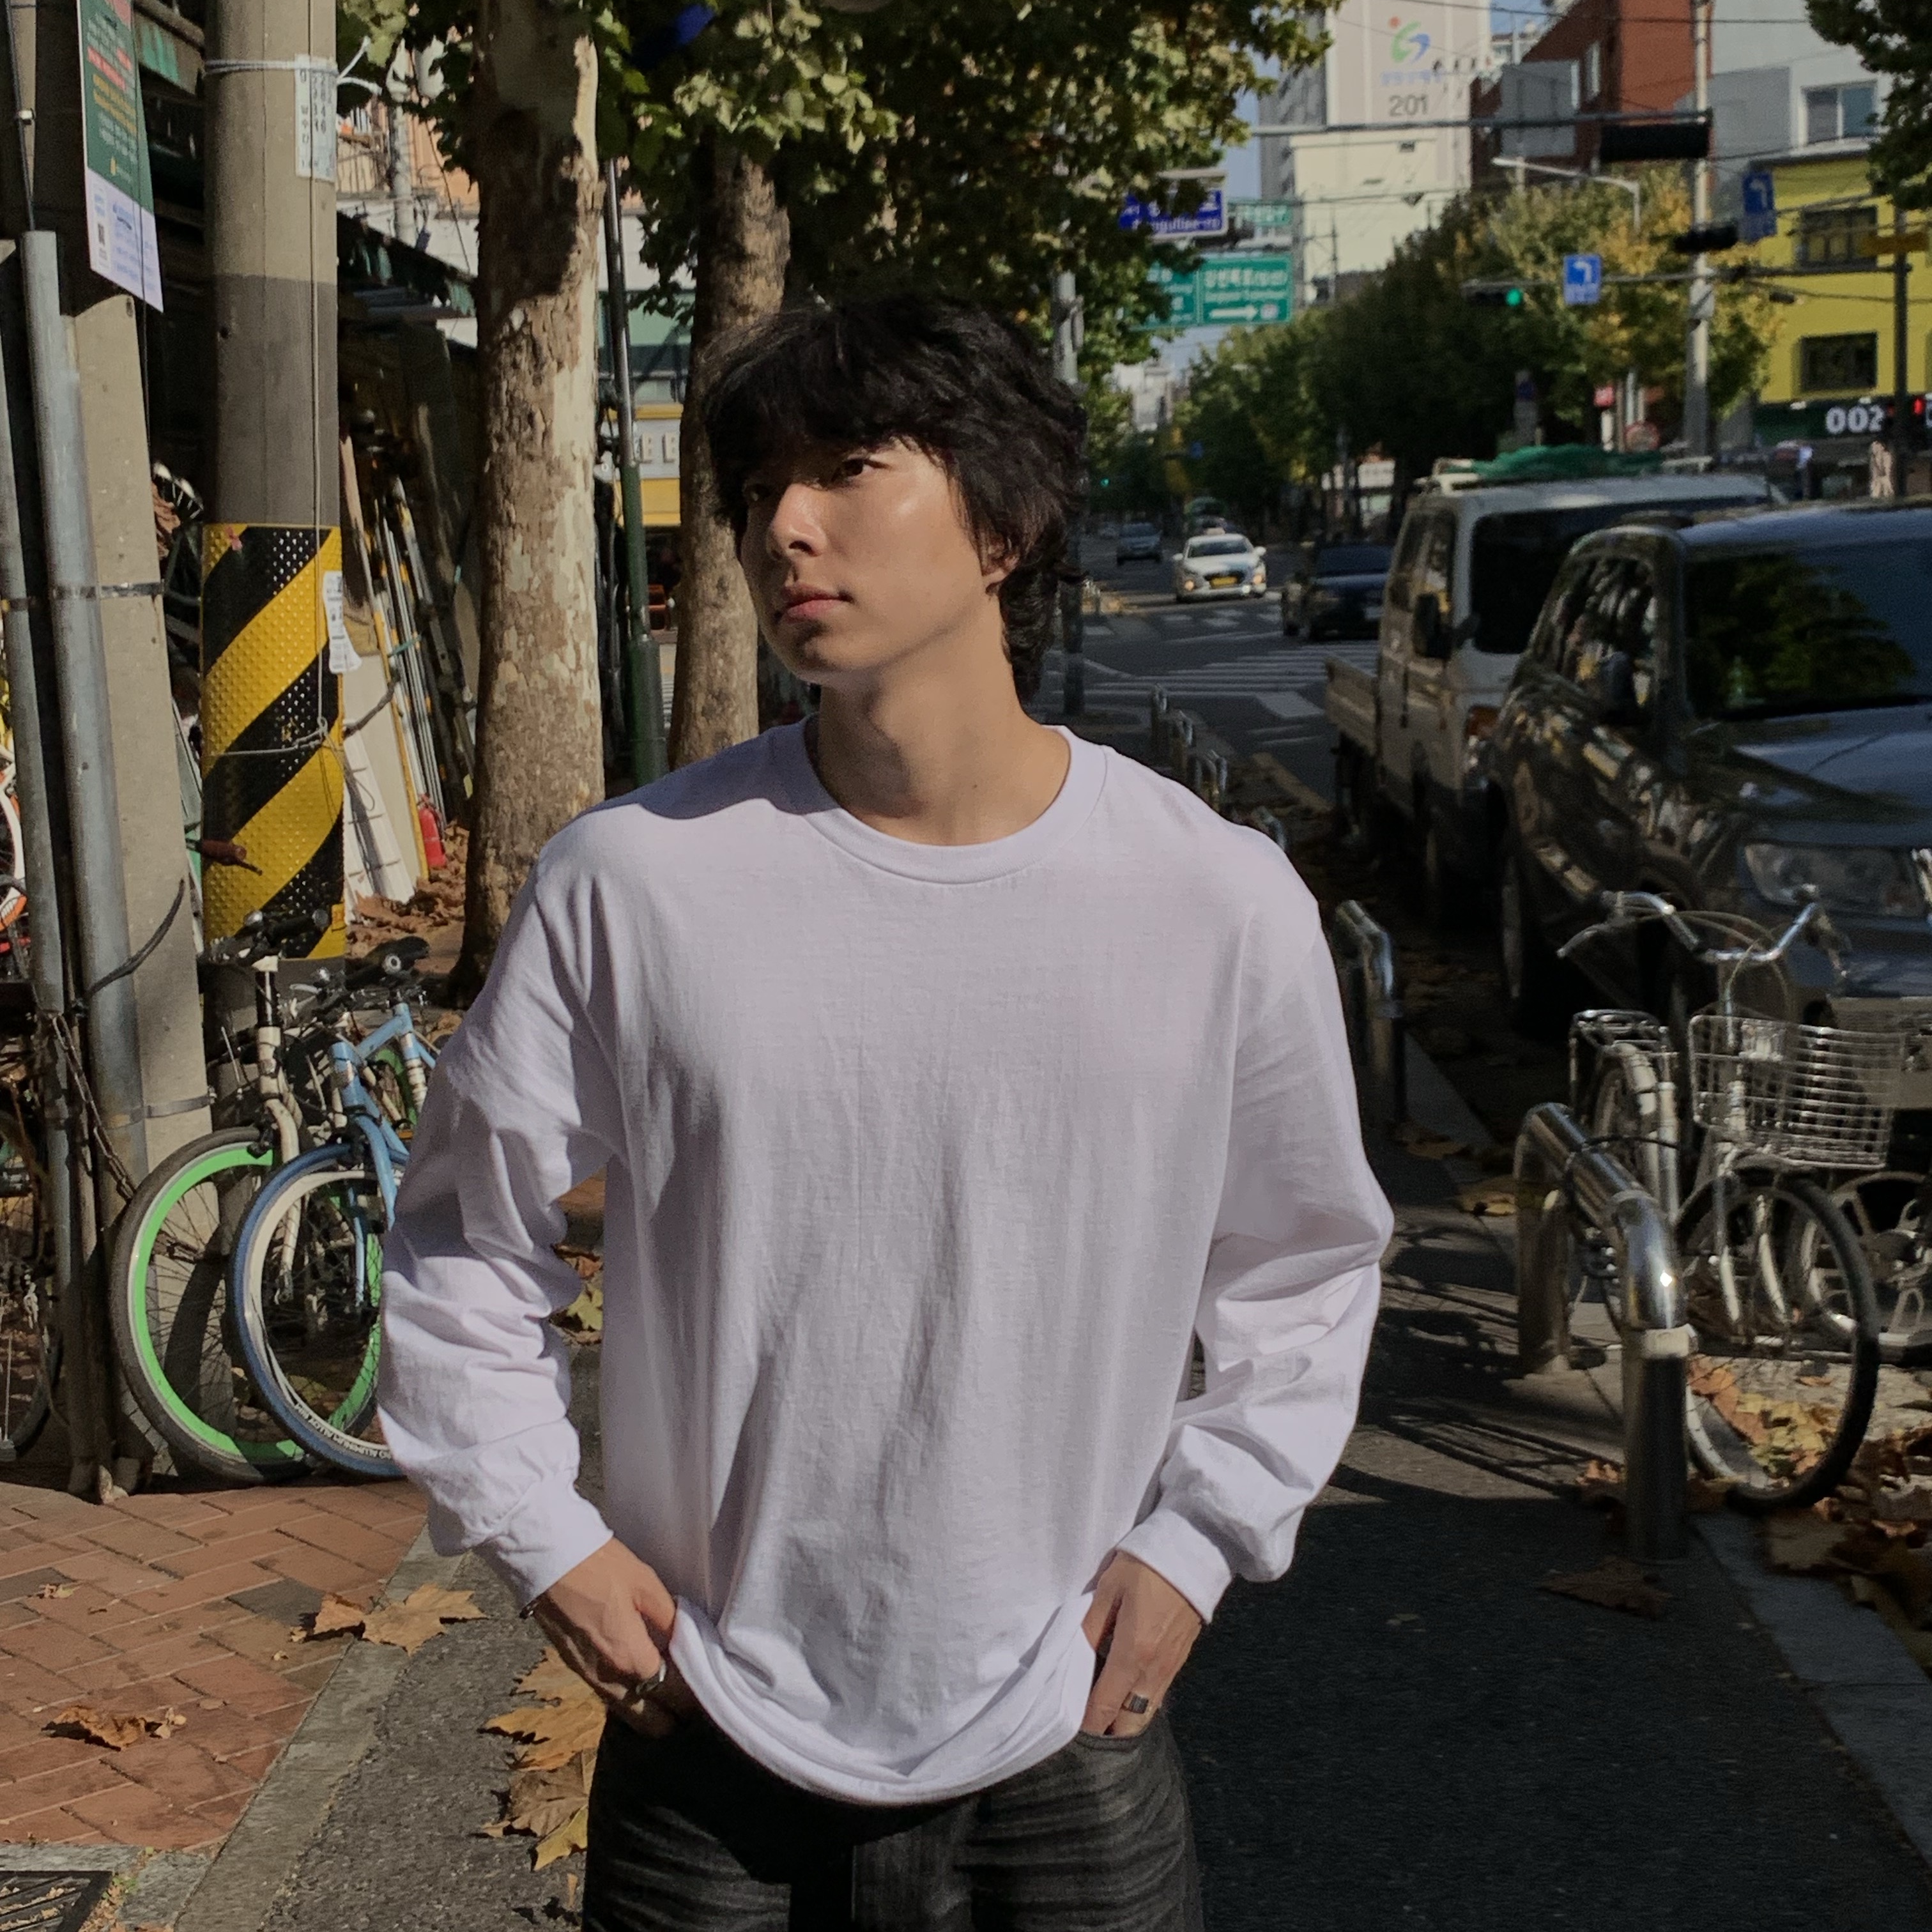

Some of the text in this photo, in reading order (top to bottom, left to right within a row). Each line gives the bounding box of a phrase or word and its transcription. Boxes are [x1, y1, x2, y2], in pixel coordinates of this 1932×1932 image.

[1389, 95, 1429, 117] 201
[1825, 404, 1885, 434] 002
[308, 1418, 334, 1438] ALLOY
